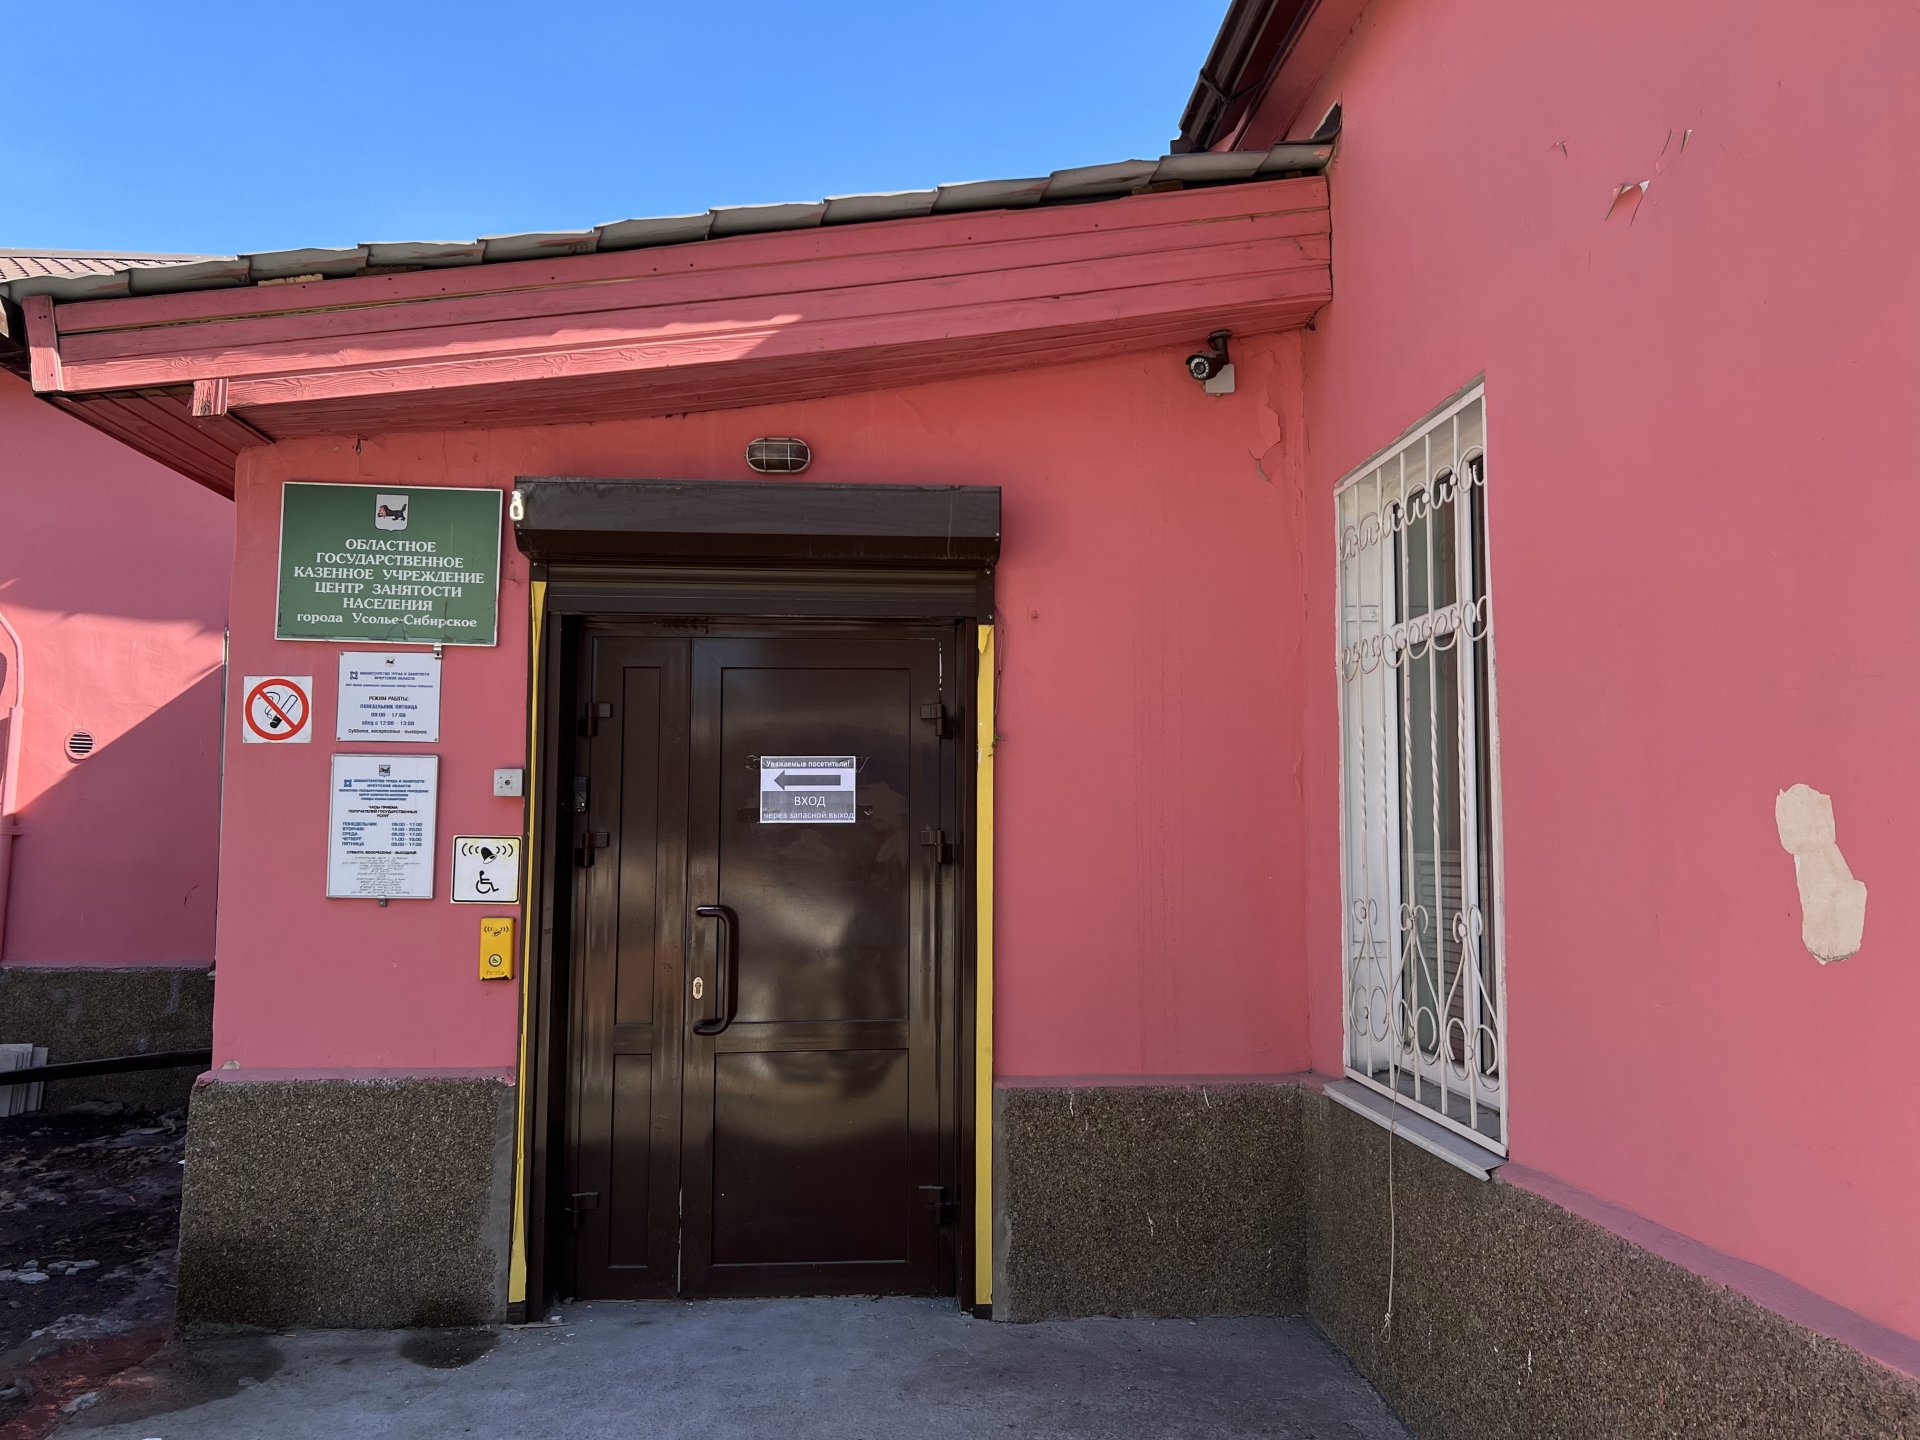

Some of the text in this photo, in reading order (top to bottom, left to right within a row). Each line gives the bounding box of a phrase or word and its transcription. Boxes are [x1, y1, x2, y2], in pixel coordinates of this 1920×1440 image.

[345, 538, 436, 553] ОБЛАСТНОЕ
[316, 552, 464, 569] ГОСУДАРСТВЕННОЕ
[294, 566, 484, 584] КАЗЕННОЕ УЧРЕЖДЕНИЕ
[315, 581, 462, 598] ЦЕНТР ЗАНЯТОСТИ
[343, 597, 433, 611] НАСЕЛЕНИЯ
[297, 612, 477, 628] города Усолье-Сибирское
[766, 760, 850, 768] Уважаемые посетители!
[794, 796, 826, 808] ВХОД
[763, 811, 855, 821] через запасной выход
